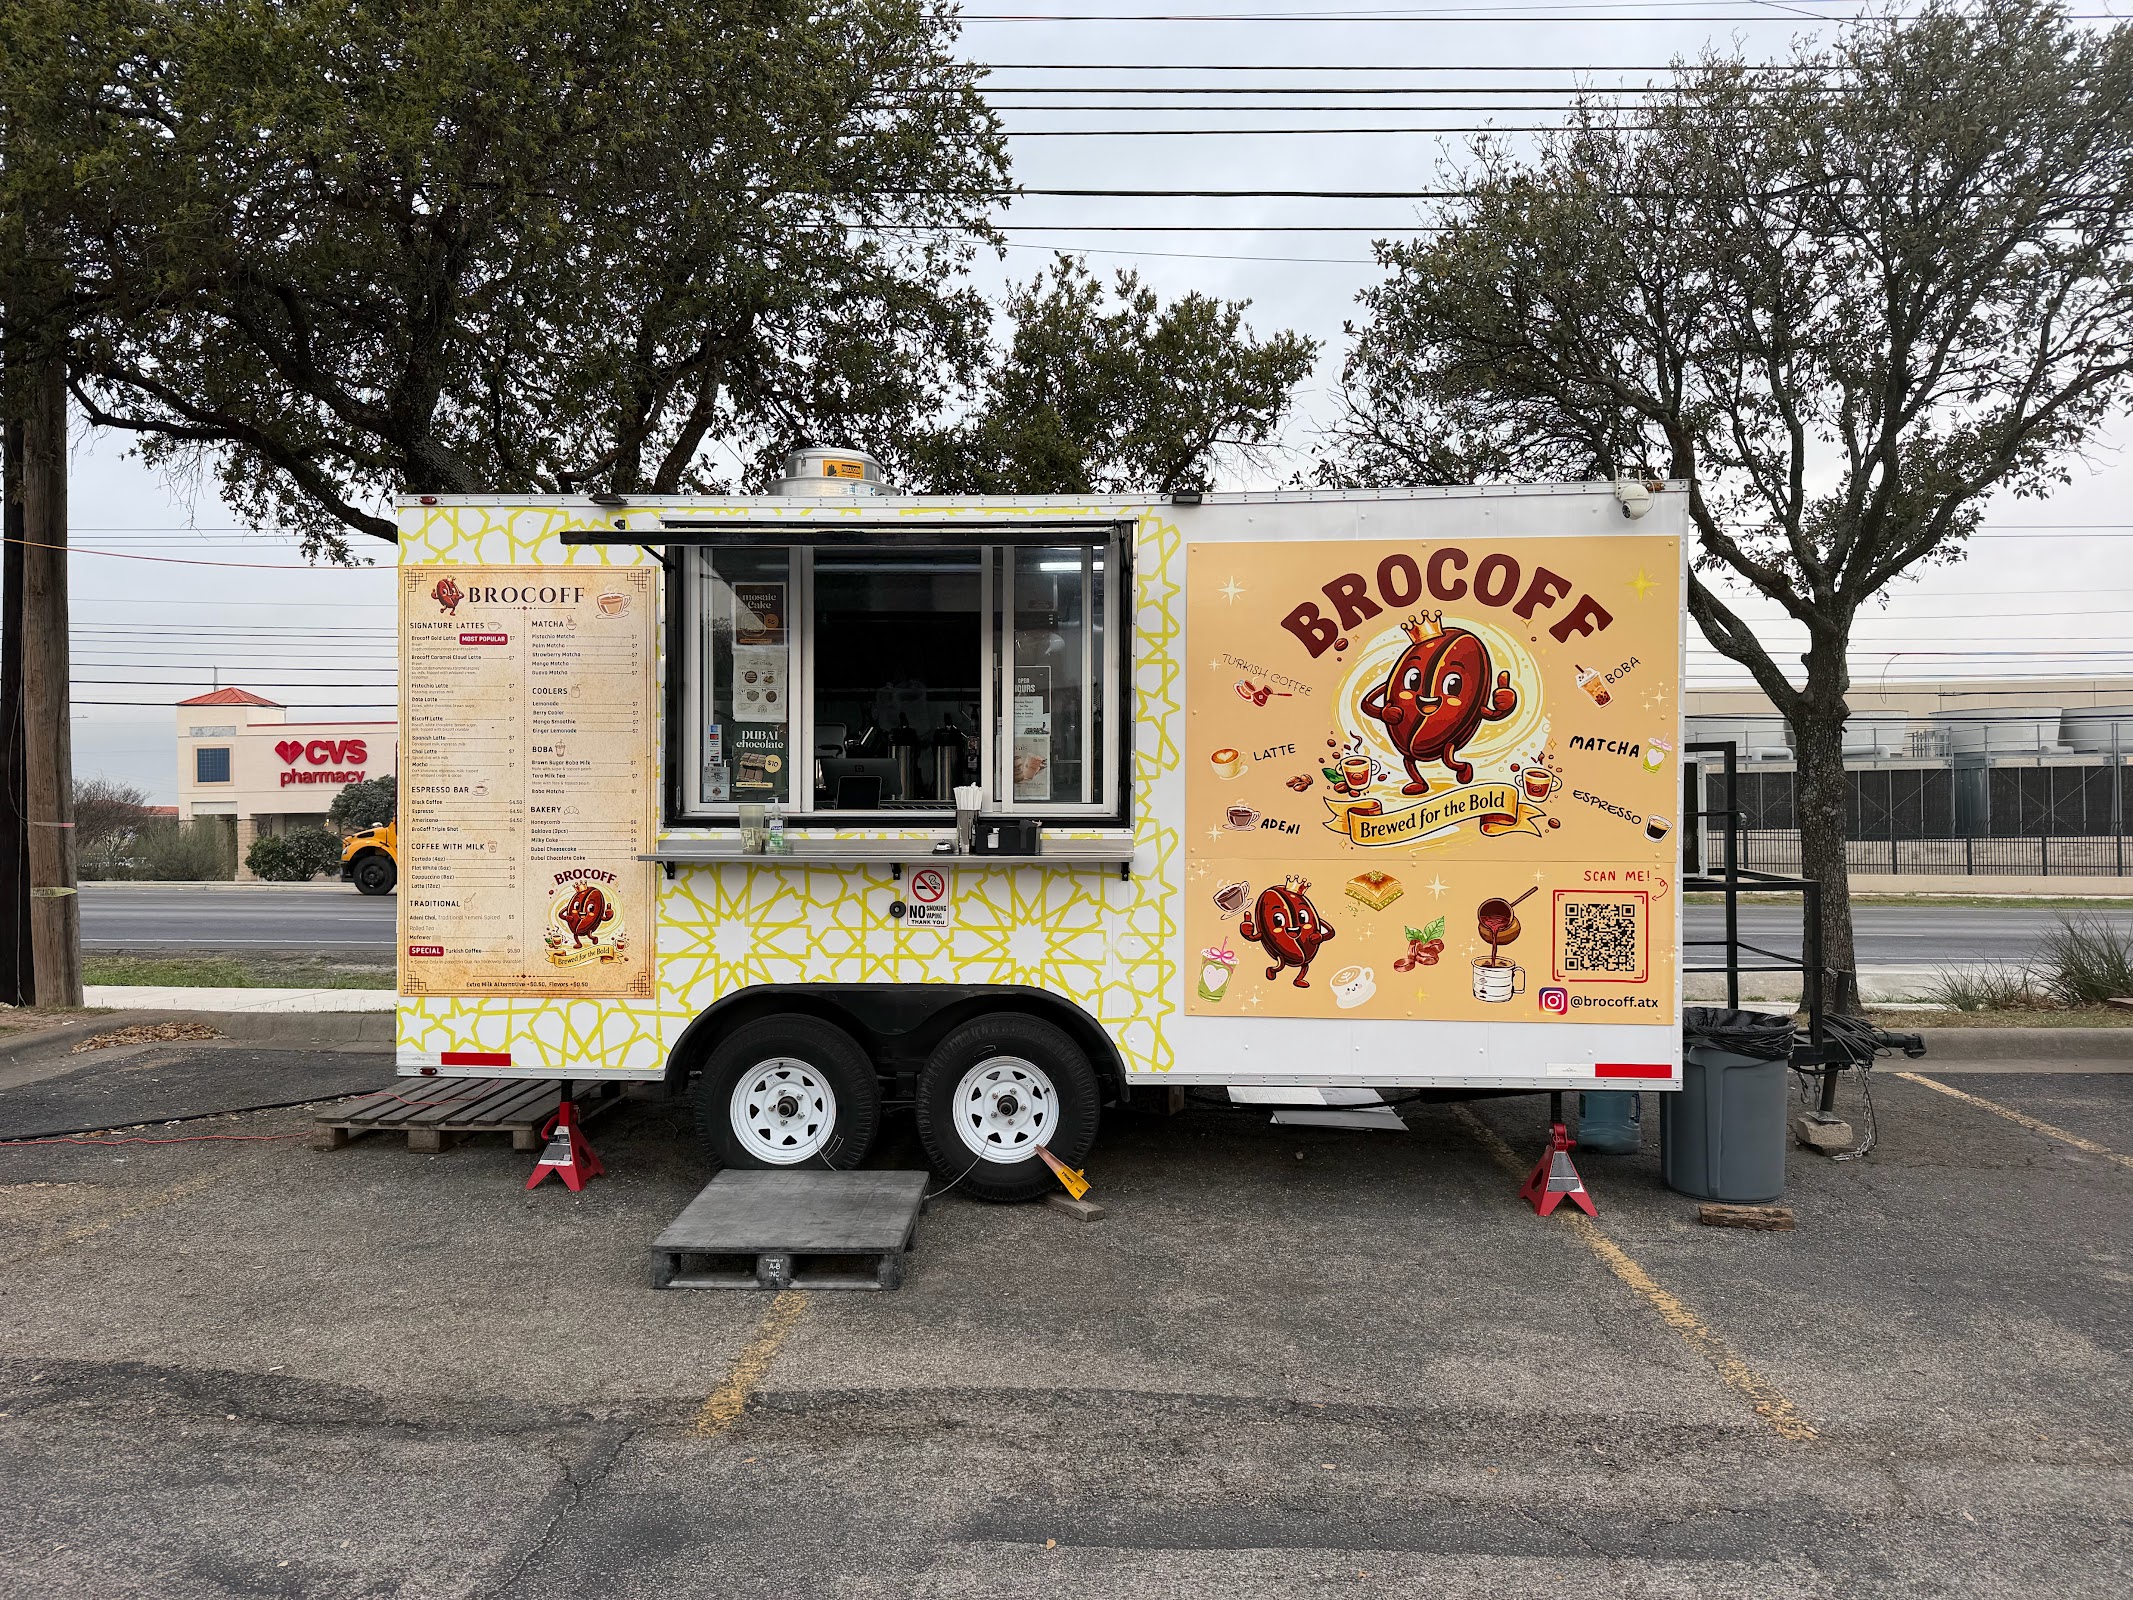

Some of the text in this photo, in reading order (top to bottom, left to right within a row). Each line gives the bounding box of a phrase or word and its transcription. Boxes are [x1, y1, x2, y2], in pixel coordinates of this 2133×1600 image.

[468, 586, 585, 604] BROCOFF
[742, 593, 777, 601] mosaic
[1280, 547, 1614, 659] BROCOFF
[747, 600, 772, 609] Cake
[409, 622, 485, 630] SIGNATURE LATTES
[531, 620, 564, 628] MATCHA
[1221, 652, 1313, 698] TURKISH COFFEE
[1603, 655, 1643, 686] BOBA
[532, 687, 568, 695] COOLERS
[741, 730, 778, 740] DUBAI
[305, 739, 368, 765] CVS
[735, 740, 784, 749] chocolate
[1253, 742, 1297, 762] LATTE
[1569, 735, 1640, 759] MATCHA
[280, 768, 366, 788] pharmacy
[411, 786, 470, 794] ESPRESSO BAR
[530, 806, 562, 814] BAKERY
[1359, 791, 1506, 839] Brewed for the Bold
[1572, 789, 1642, 826] ESPRESSO
[1260, 816, 1301, 836] ADENI
[553, 868, 617, 886] BROCOFF
[1583, 869, 1652, 883] SCAN ME!
[909, 905, 926, 919] NO
[557, 946, 611, 965] Brewed for the Bold
[1570, 994, 1660, 1011] @brocoff.atx
